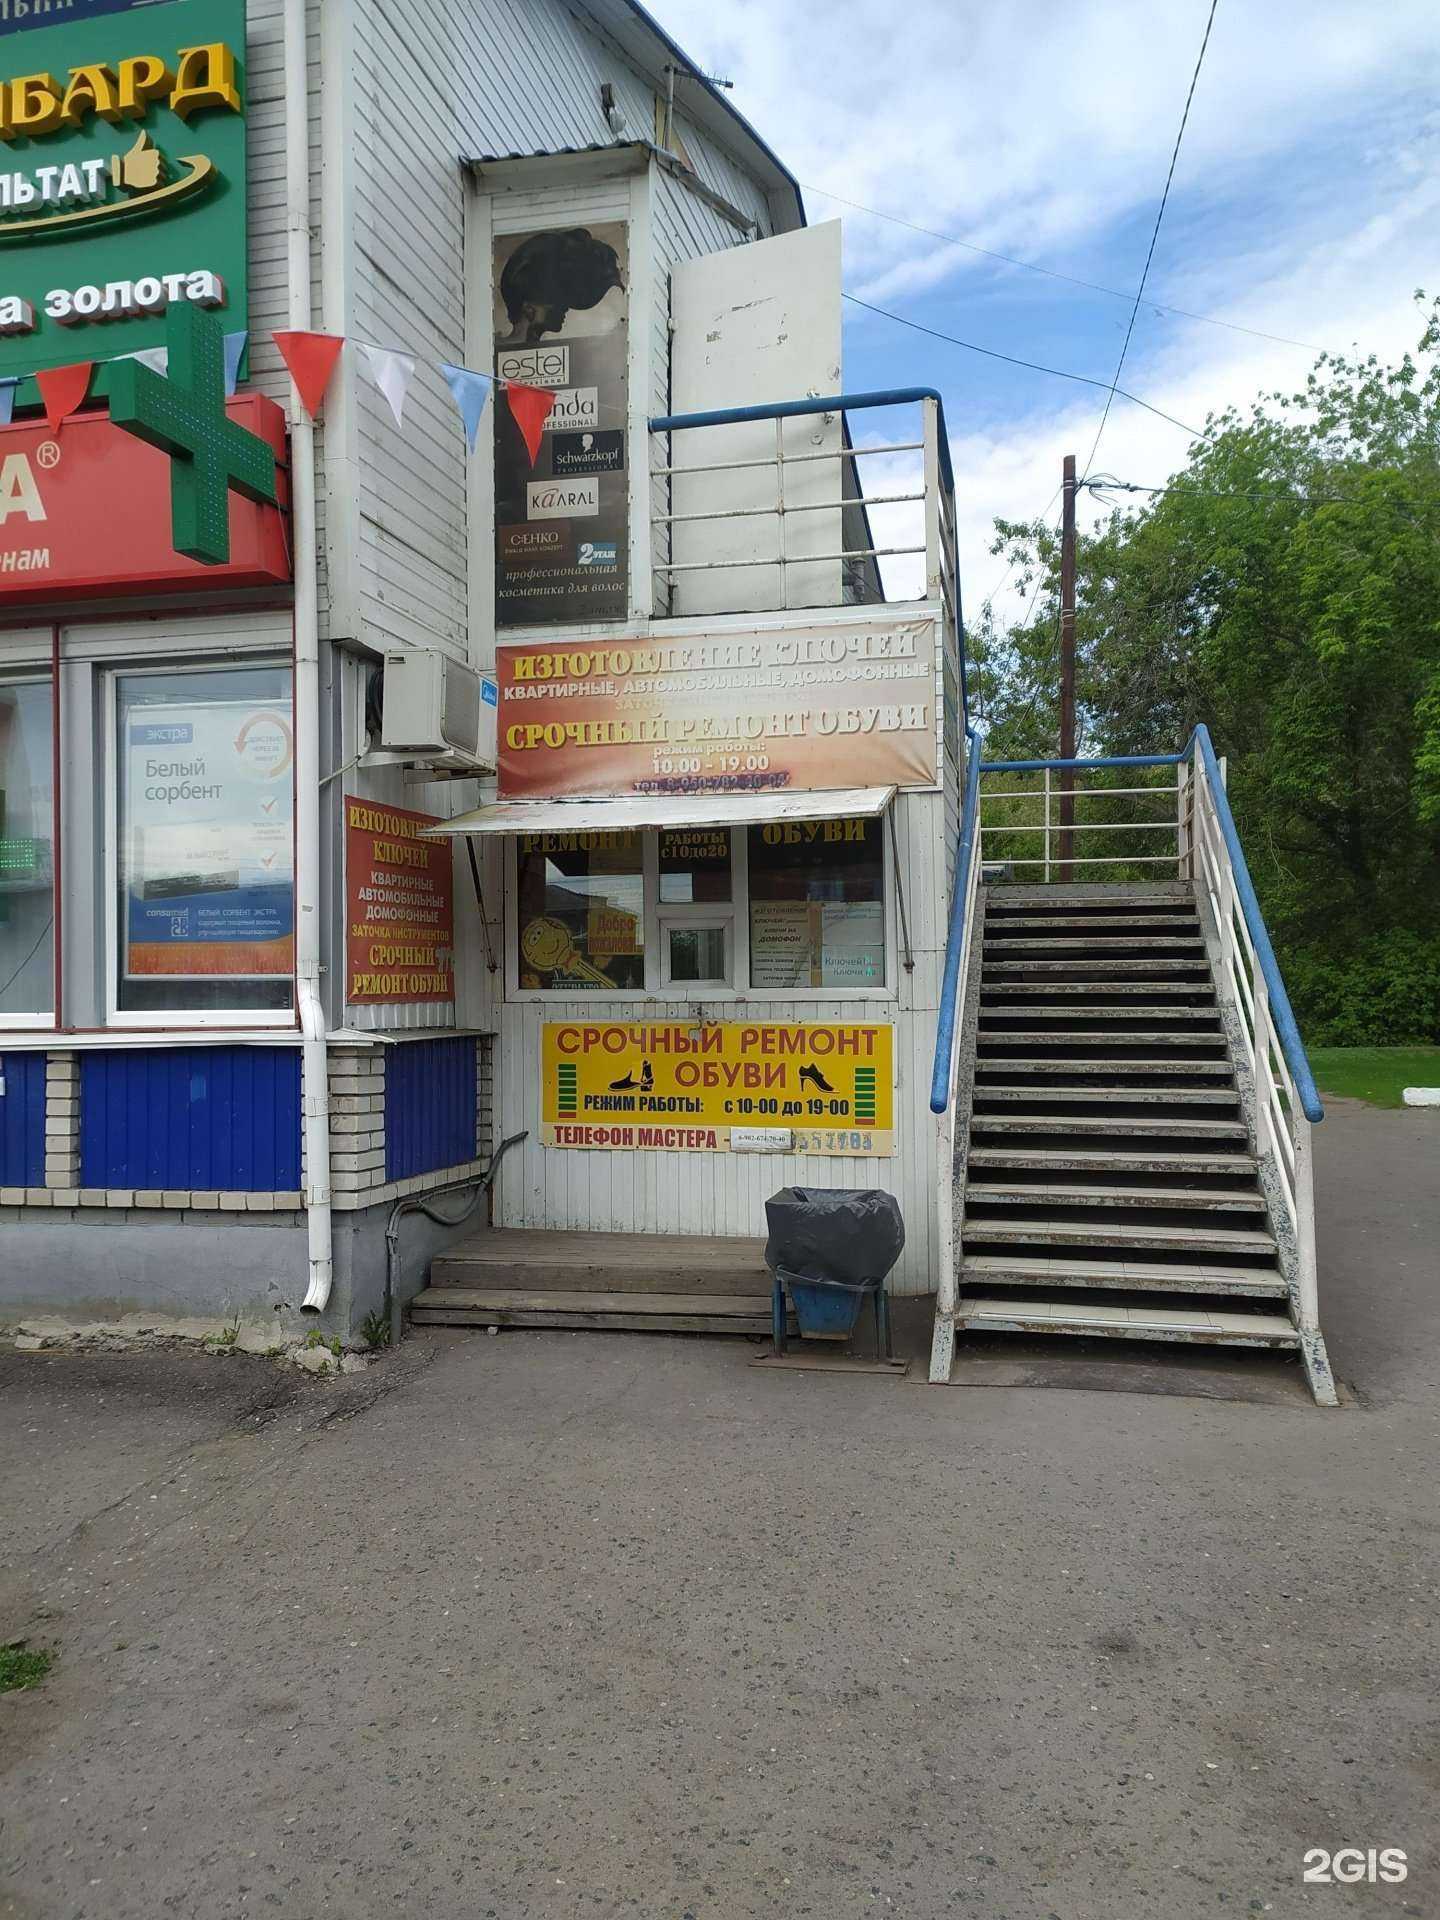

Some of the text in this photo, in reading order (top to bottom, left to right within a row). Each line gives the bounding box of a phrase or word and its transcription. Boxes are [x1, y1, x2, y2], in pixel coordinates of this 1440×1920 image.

[0, 43, 240, 129] БАРД
[45, 270, 217, 318] золота
[502, 348, 566, 380] estel
[545, 391, 595, 417] nda
[556, 449, 618, 465] Schwarzkopf
[0, 548, 49, 573] нам
[578, 543, 593, 565] 2
[506, 564, 618, 583] профессиональная
[499, 581, 625, 598] косметика для волос
[512, 625, 917, 681] ИЗГОТОВЛЕНИЕ КЛЮЧЕЙ
[789, 663, 930, 688] ДОМОФОННЫЕ
[146, 728, 188, 742] экстра
[506, 703, 929, 750] СРОЧНЫЙ РЕМОНТ ОБУВИ
[145, 757, 206, 778] Белый
[652, 757, 700, 774] 10.00
[719, 755, 769, 772] 19.00
[145, 781, 223, 804] сорбент
[523, 831, 637, 853] РЕМОНТ
[664, 831, 727, 845] РАБОТЫ
[762, 819, 866, 845] ОБУВИ
[372, 840, 429, 869] КЛЮЧЕЙ
[370, 871, 434, 891] КВАРТИРНЫЕ
[358, 887, 445, 908] АВТОМОБИЛЬНЫЕ
[366, 905, 439, 923] ДОМОФОННЫЕ
[351, 924, 391, 938] ЗАТОЧКА
[369, 941, 435, 967] СРОЧНЫЙ
[352, 973, 449, 995] РЕМОНТ ОБУВИ
[557, 1020, 879, 1056] СРОЧНЫЙ РЕМОНТ
[675, 1060, 787, 1089] ОБУВИ
[584, 1095, 635, 1111] РЕЖИМ
[639, 1096, 705, 1113] РАБОТЫ:
[736, 1098, 778, 1114] 10-00
[781, 1100, 803, 1116] до
[805, 1098, 850, 1115] 19-00
[554, 1125, 633, 1146] ТЕЛЕФОН
[638, 1128, 718, 1149] МАСТЕРА
